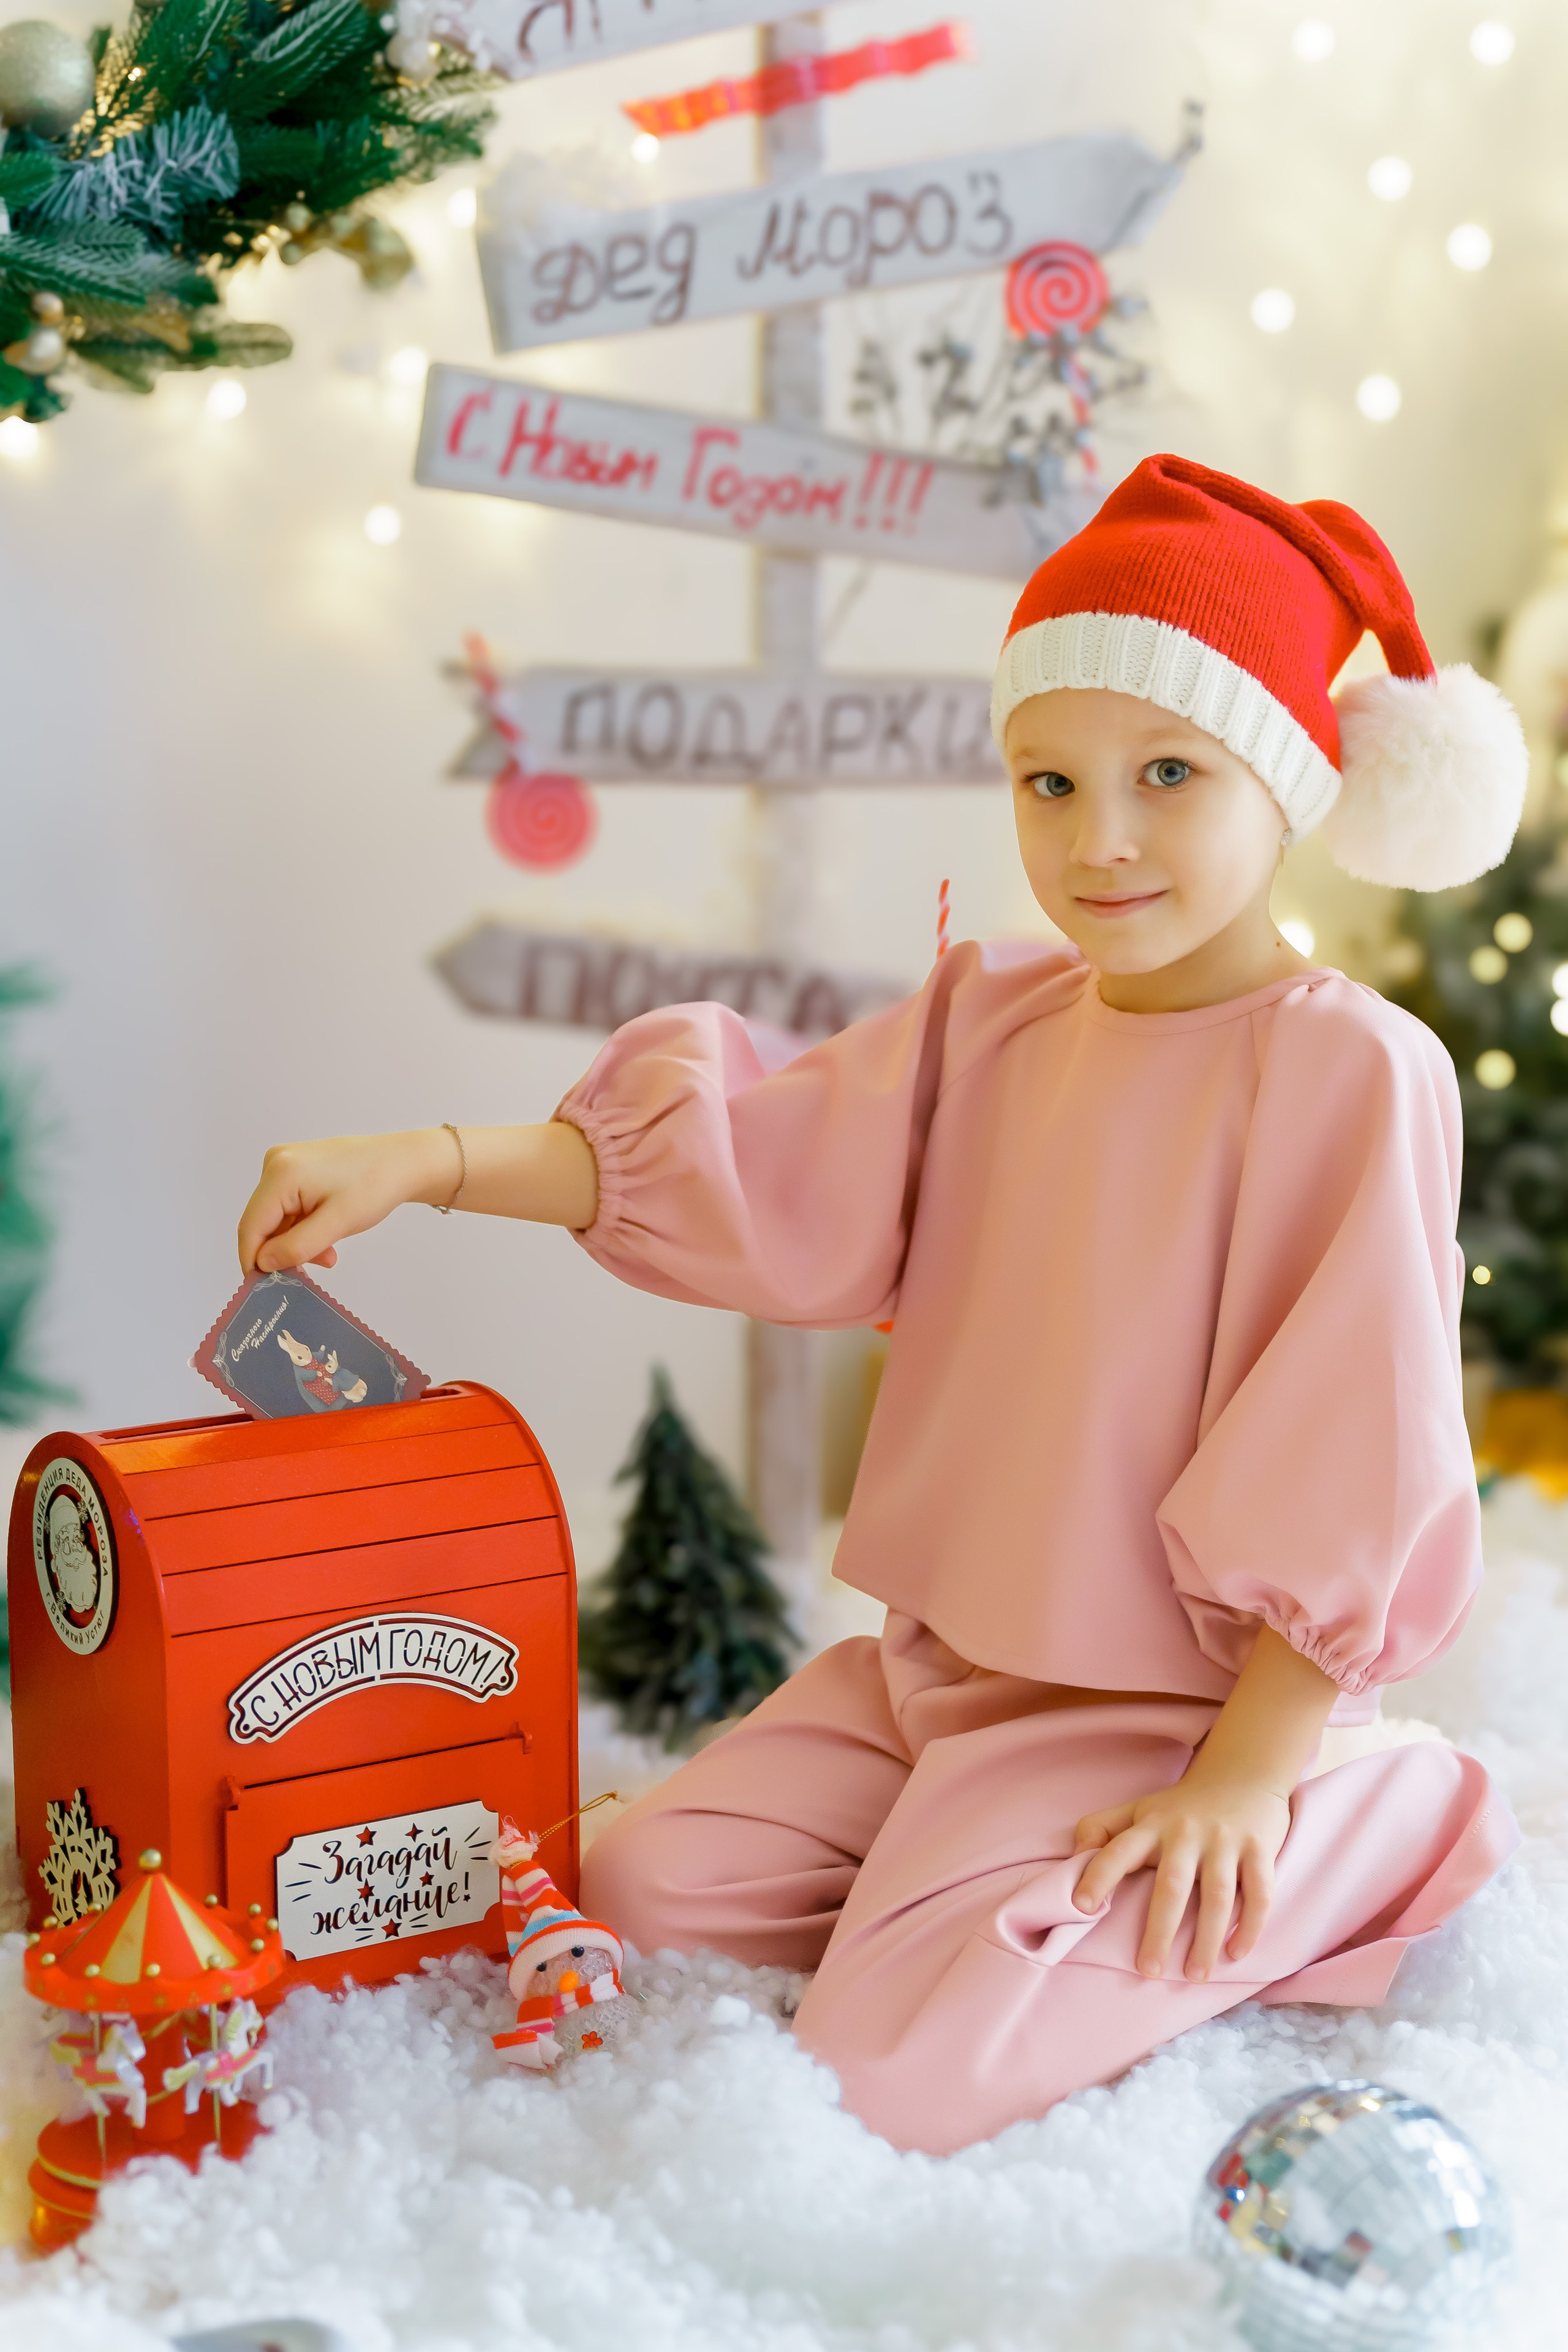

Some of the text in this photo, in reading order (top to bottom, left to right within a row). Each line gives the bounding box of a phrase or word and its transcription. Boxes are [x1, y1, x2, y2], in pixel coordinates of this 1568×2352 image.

[232, 1318, 262, 1362] Сказочного
[36, 1468, 108, 1577] РЕЗИДЕНЦИЯ ДЕДА МОРОЗА
[251, 1629, 505, 1726] С НОВЫМ ГОДОМ!
[322, 1826, 458, 1889] Загадай
[309, 1871, 472, 1936] желание!
